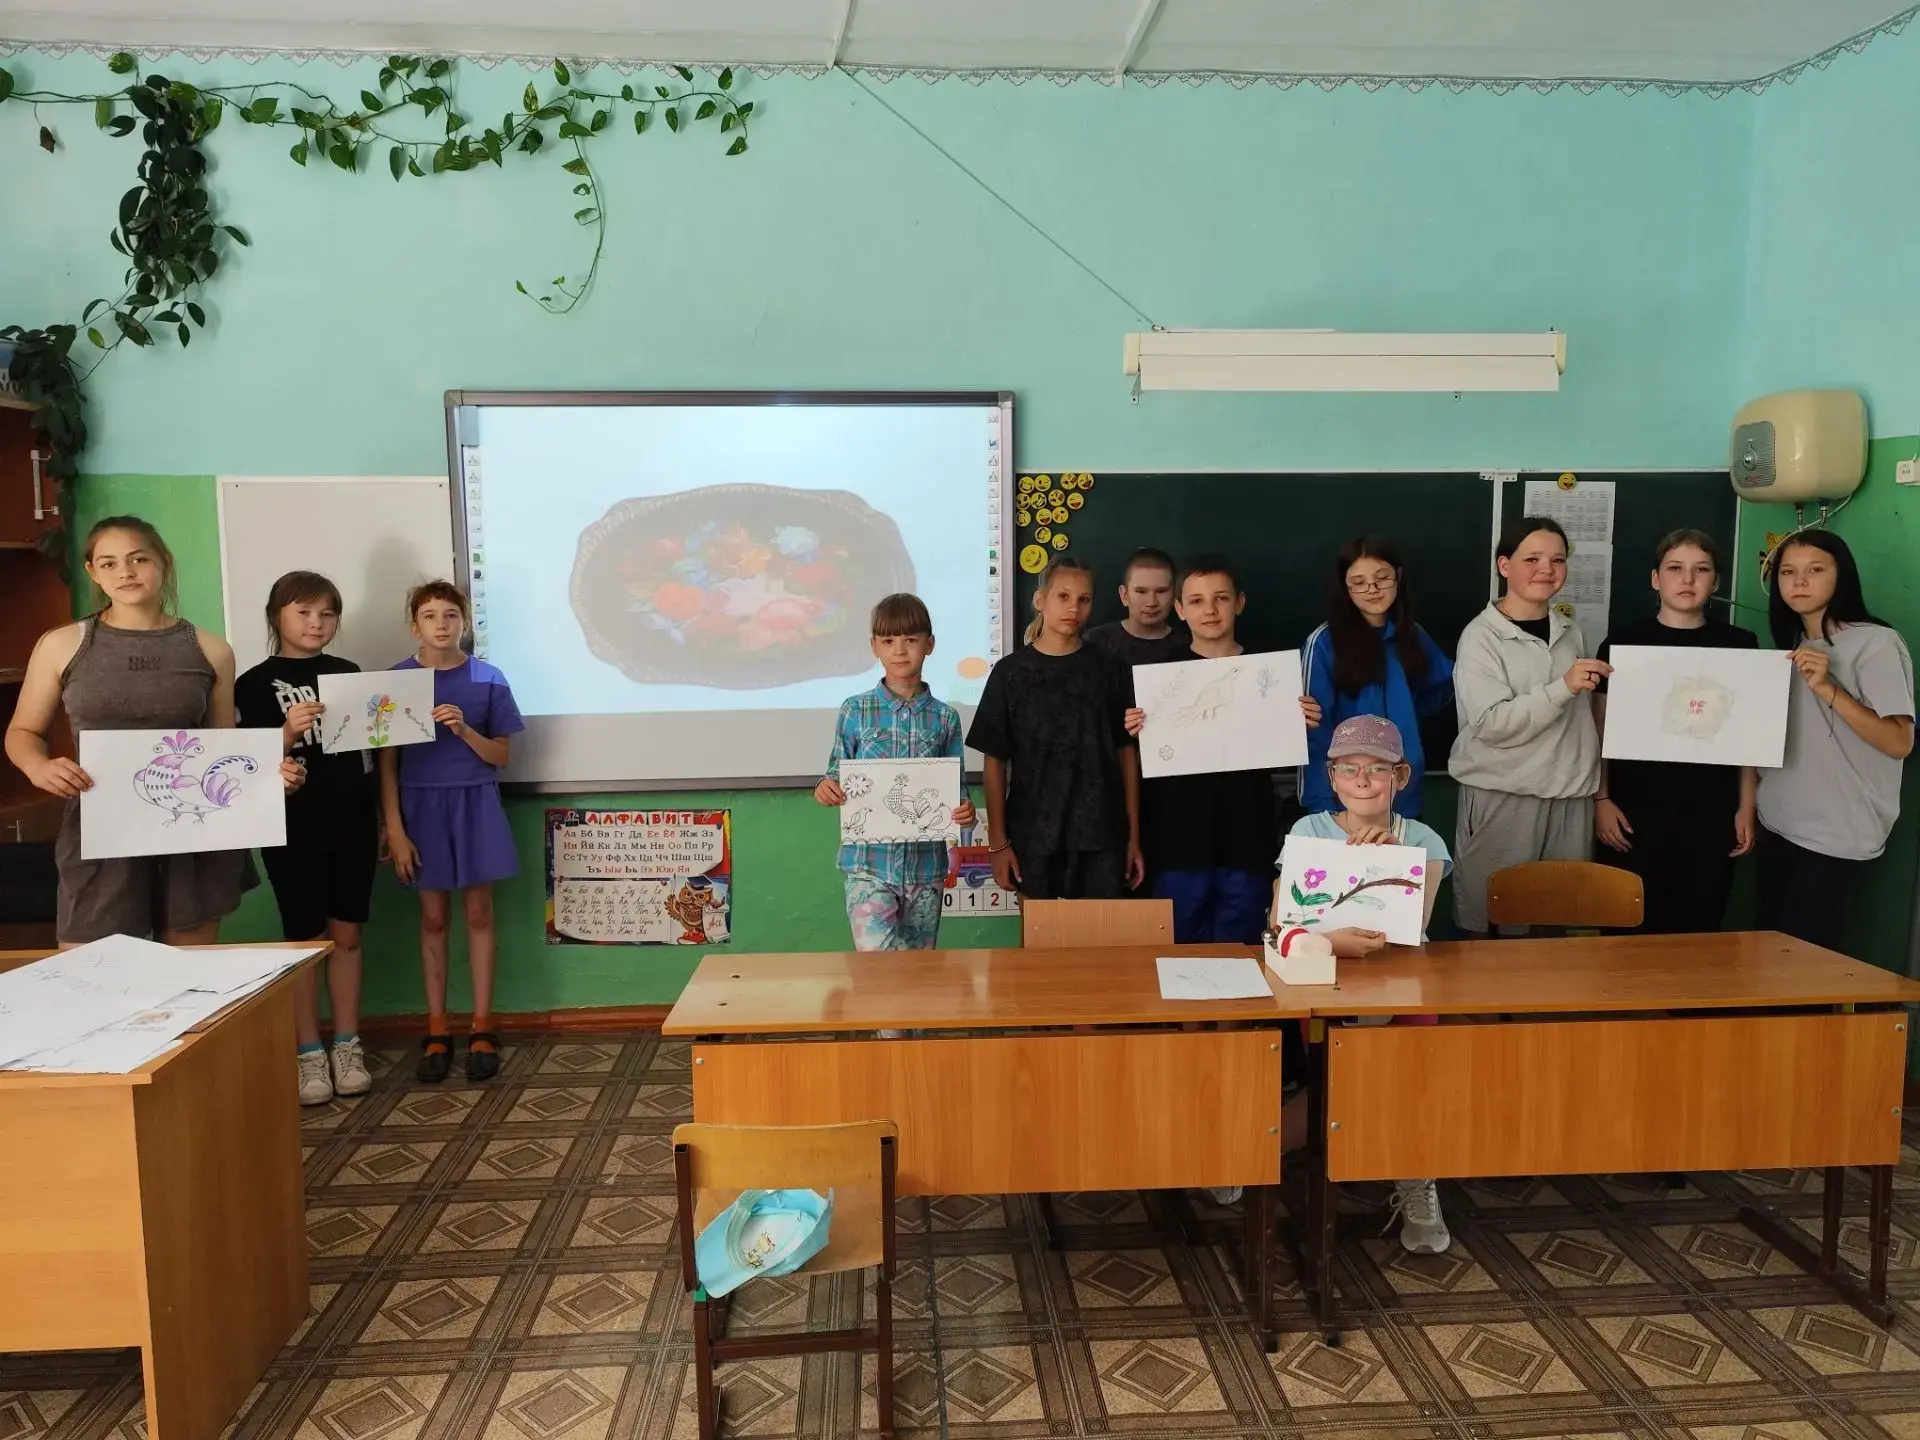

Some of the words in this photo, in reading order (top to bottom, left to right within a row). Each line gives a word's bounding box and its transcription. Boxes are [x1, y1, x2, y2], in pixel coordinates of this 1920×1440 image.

[587, 813, 691, 825] АЛФАВИТ
[563, 830, 576, 838] Аа
[580, 830, 593, 838] Бб
[597, 830, 610, 838] Вв
[614, 830, 625, 838] Гг
[628, 830, 643, 839] Дд
[647, 830, 660, 838] Ее
[663, 829, 676, 838] Ёё
[679, 830, 698, 838] Жж
[702, 830, 714, 838] Зз
[563, 842, 578, 850] Ии
[580, 841, 595, 850] Йй
[597, 842, 611, 850] Кк
[613, 842, 627, 850] Лл
[630, 842, 647, 850] Мм
[650, 842, 665, 850] Нн
[668, 842, 682, 850] Оо
[684, 842, 698, 850] Пп
[701, 842, 714, 851] Рр
[944, 894, 953, 907] 0
[969, 893, 975, 907] 1
[991, 893, 999, 906] 2
